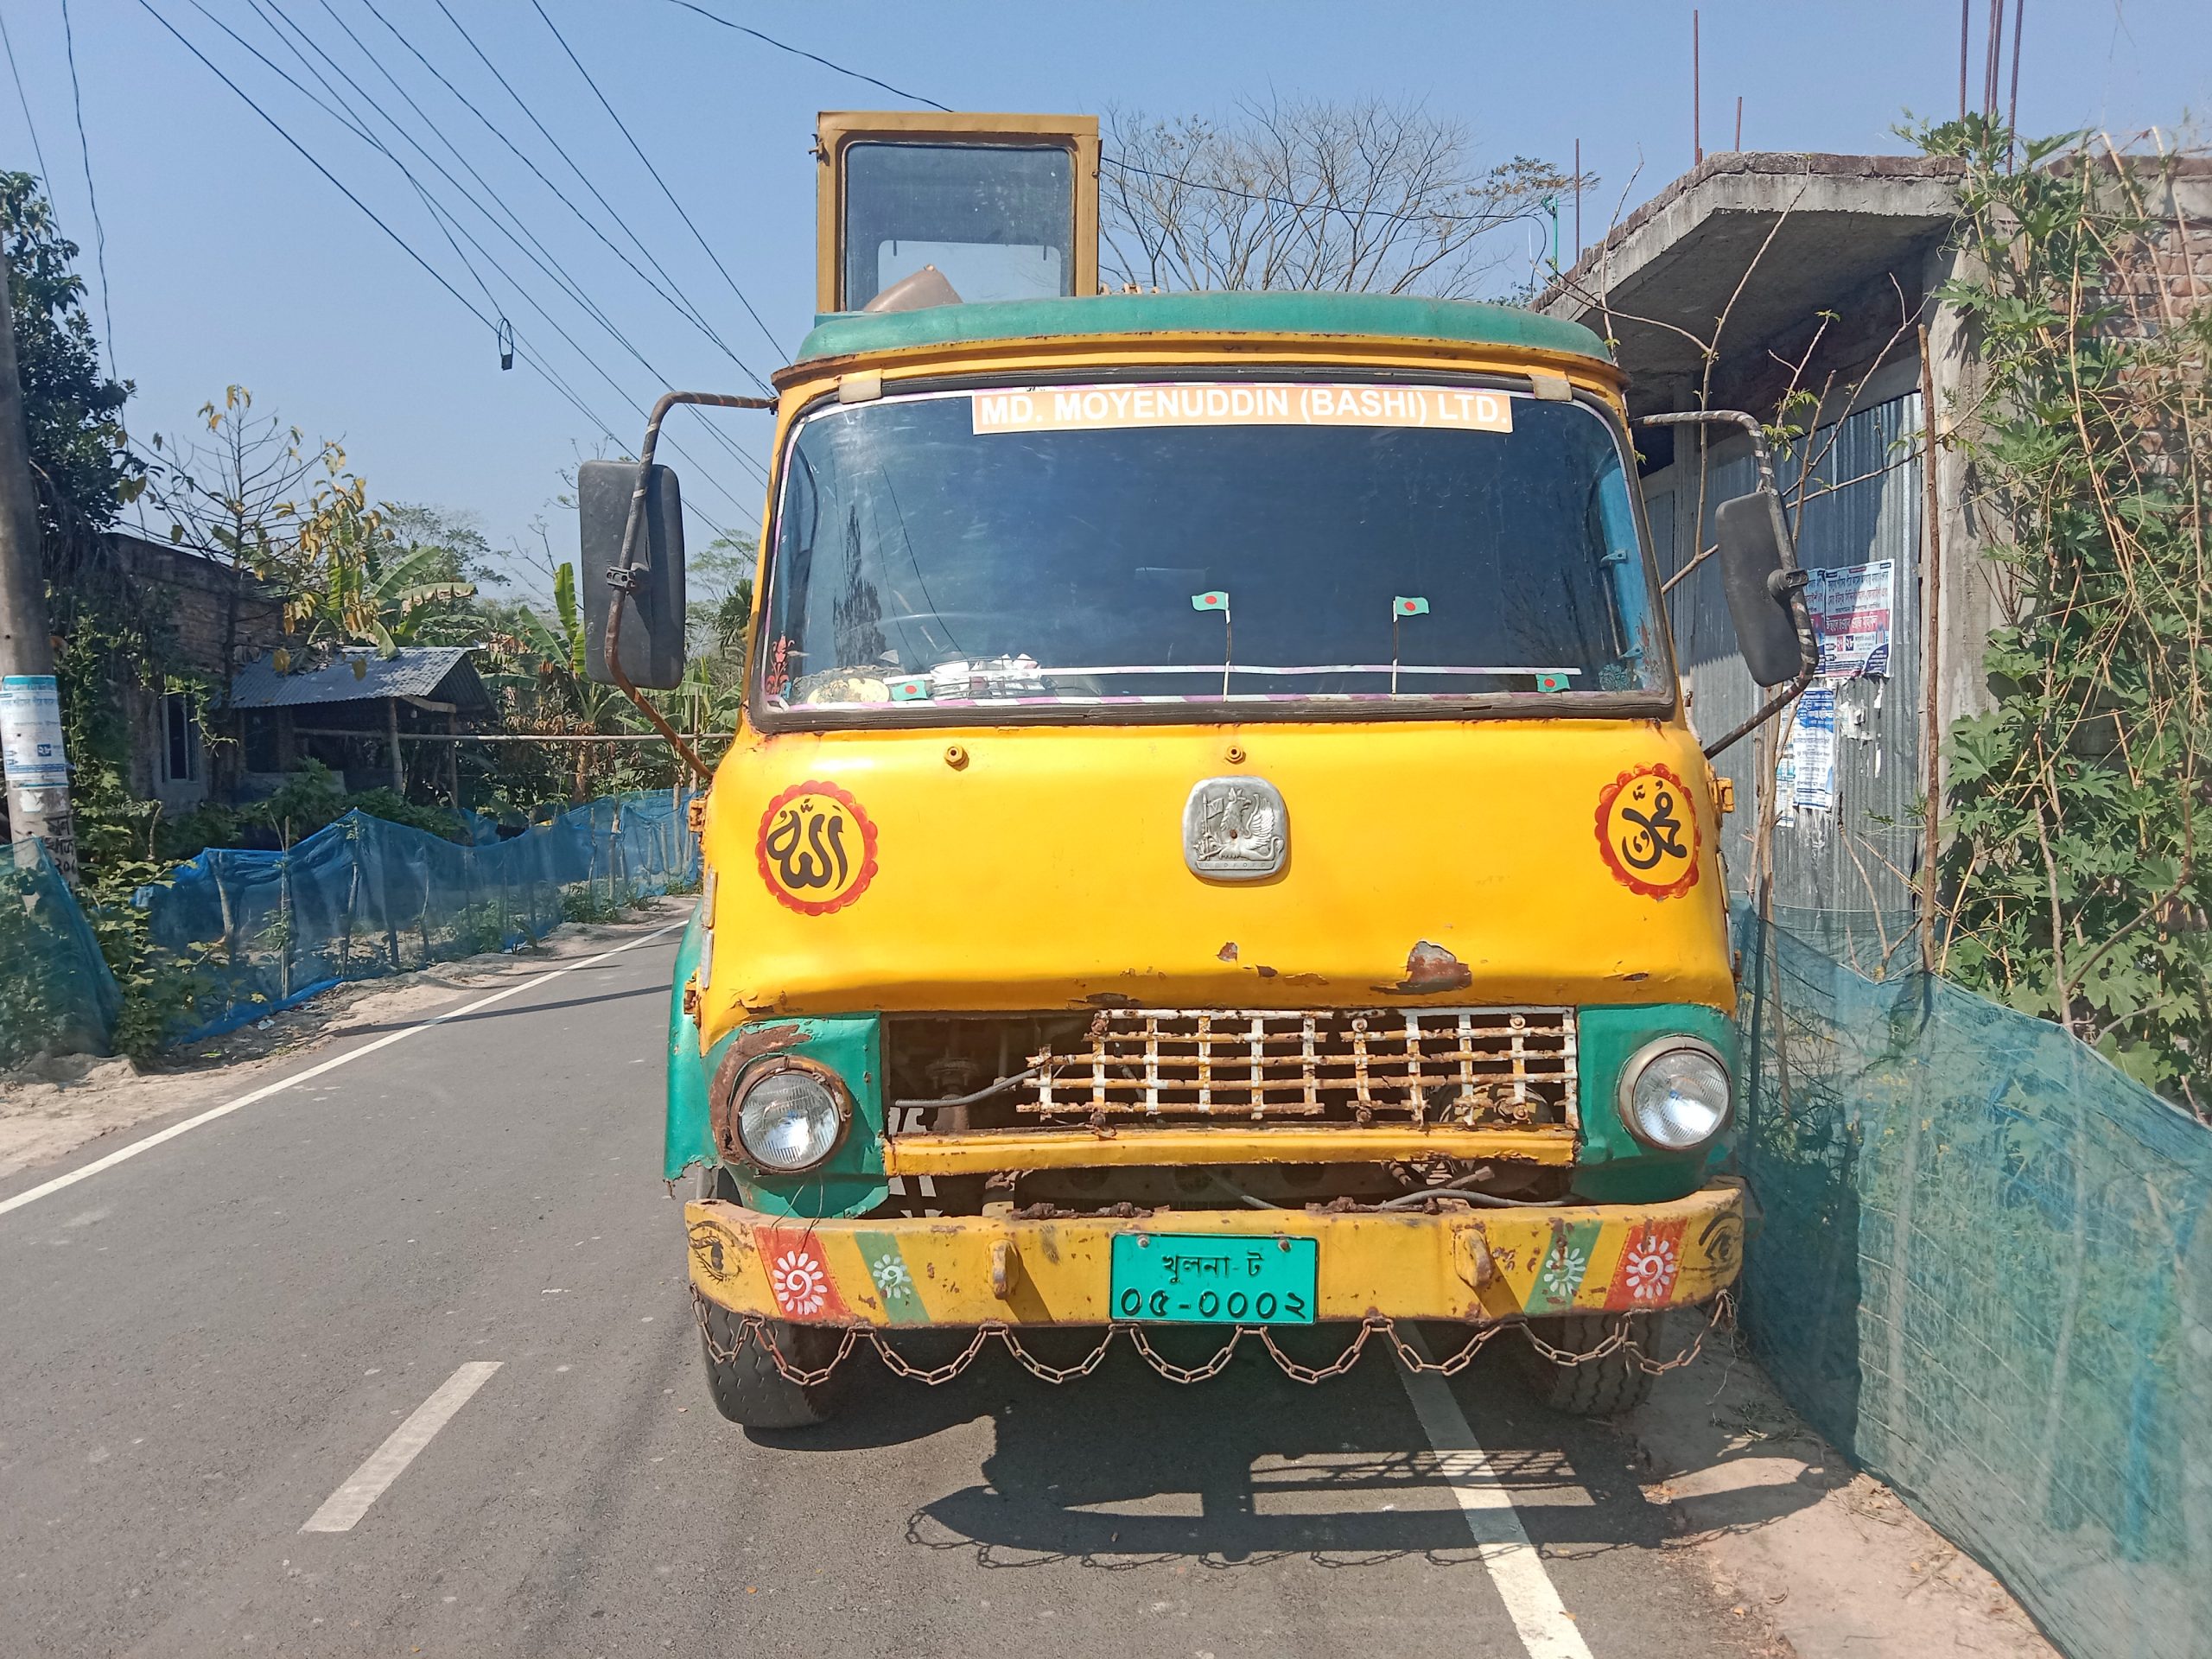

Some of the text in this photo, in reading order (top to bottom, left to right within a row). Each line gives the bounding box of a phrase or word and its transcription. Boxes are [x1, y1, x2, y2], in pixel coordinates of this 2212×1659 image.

[981, 389, 1507, 426] MD. MOYENUDDIN (BASHI) LTD.
[1161, 1254, 1230, 1284] খুলনা
[1246, 1251, 1264, 1276] ট
[1121, 1287, 1306, 1319] ০৫-০০০২
